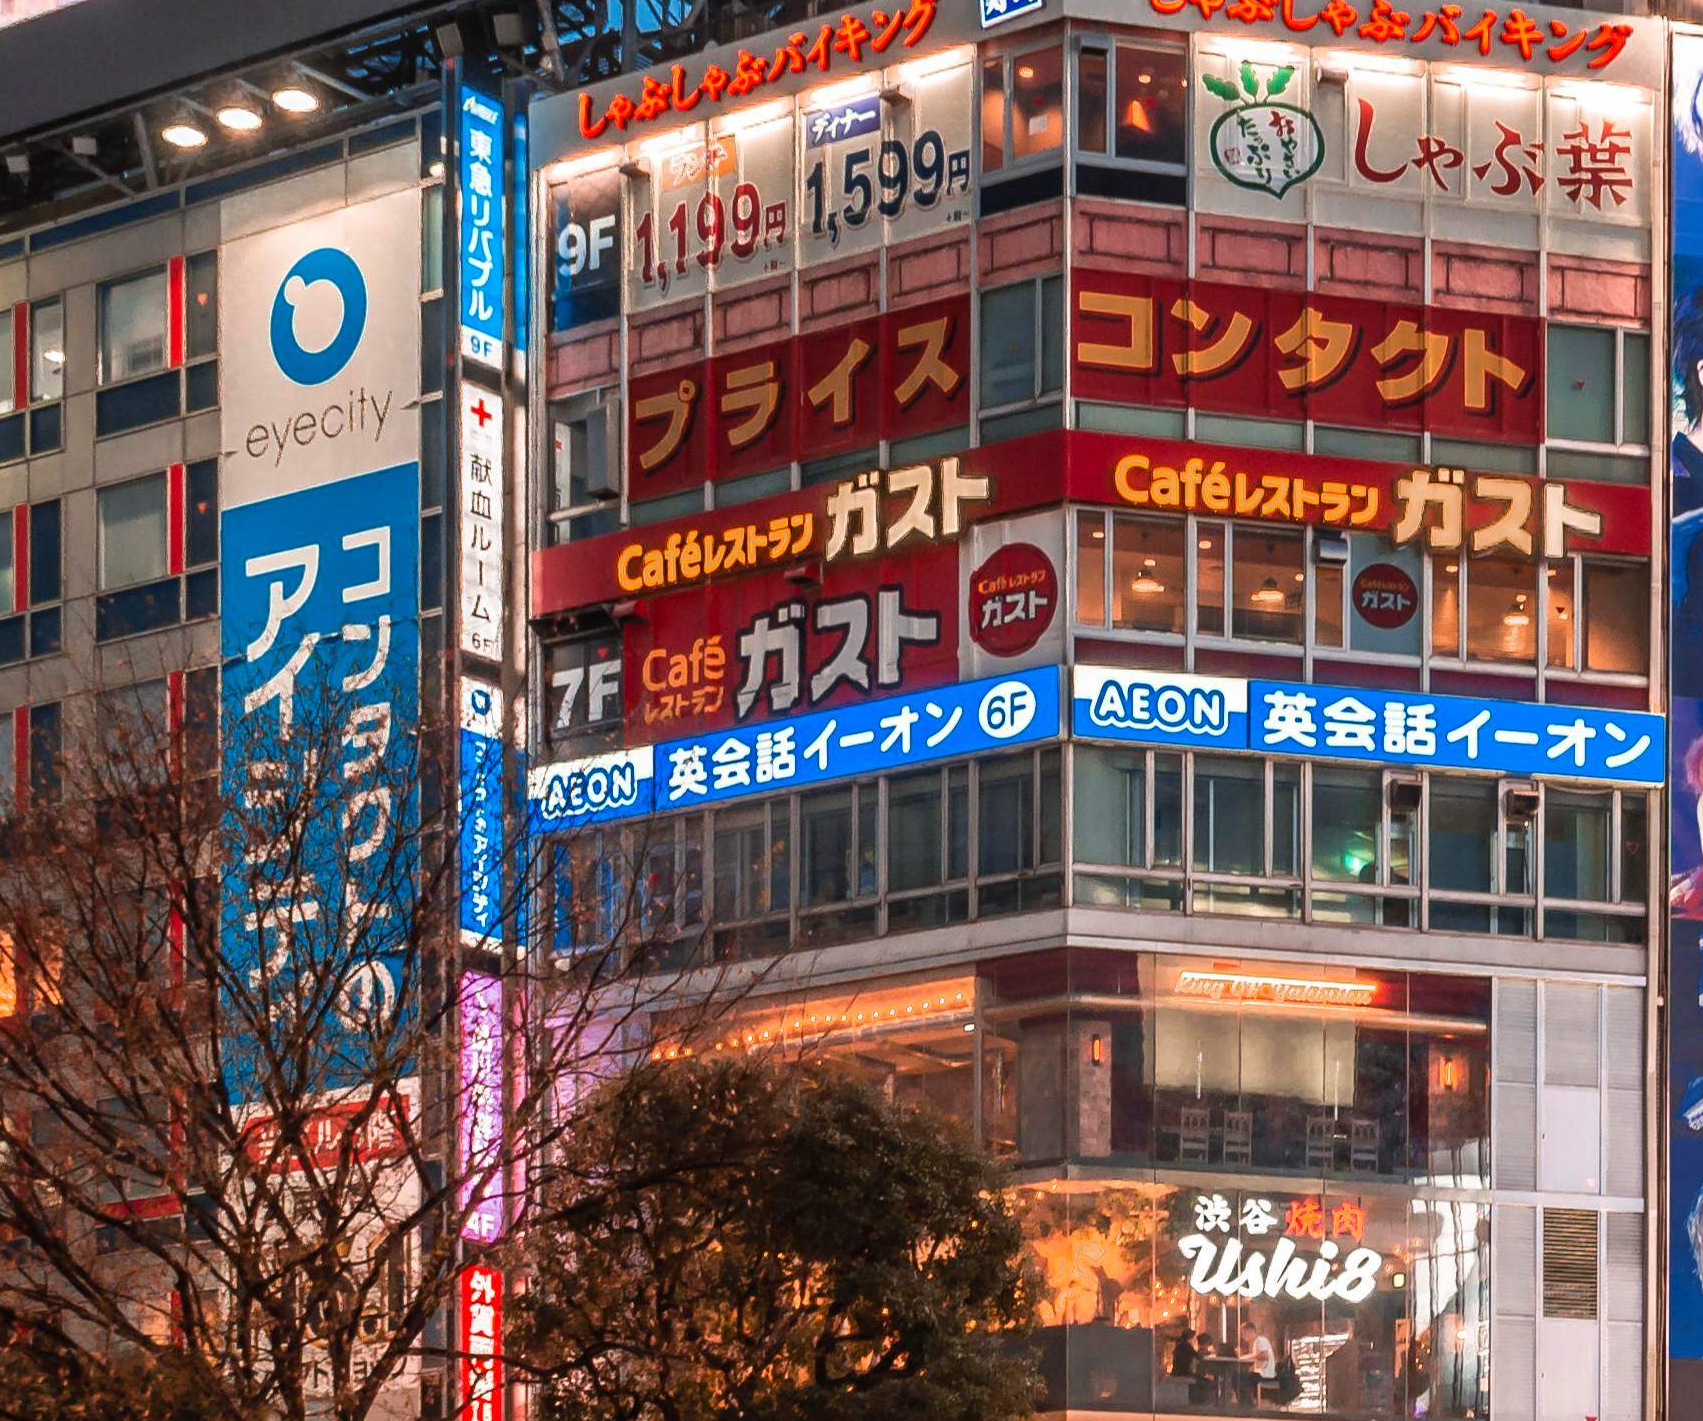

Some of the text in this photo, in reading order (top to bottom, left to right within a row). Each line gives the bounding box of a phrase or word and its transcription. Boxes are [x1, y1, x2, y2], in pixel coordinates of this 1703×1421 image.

[811, 109, 878, 143] ディナー
[1352, 96, 1635, 210] しゃぶ葉
[467, 128, 494, 323] 東急リバブル
[806, 130, 971, 251] 1,599円
[558, 215, 615, 276] 9F
[635, 182, 787, 294] 1,199円
[470, 334, 494, 360] 9F
[1078, 290, 1527, 410] コンタクト
[245, 386, 394, 469] eyecity
[634, 316, 960, 470] プライス
[470, 453, 494, 623] 献血ルーム
[824, 456, 991, 562] ガスト
[1395, 465, 1602, 561] ガスト
[471, 631, 493, 651] 6F
[980, 590, 1049, 630] ガスト
[1360, 587, 1414, 612] ガスト
[551, 659, 623, 730] 7F
[642, 635, 727, 690] Café
[734, 590, 941, 720] ガスト
[643, 684, 726, 726] レストラン
[1096, 684, 1652, 770] AEON 英会話イーオン
[546, 685, 1031, 814] AEON 英会話イーオン 6F
[1178, 1232, 1383, 1304] Ushi8
